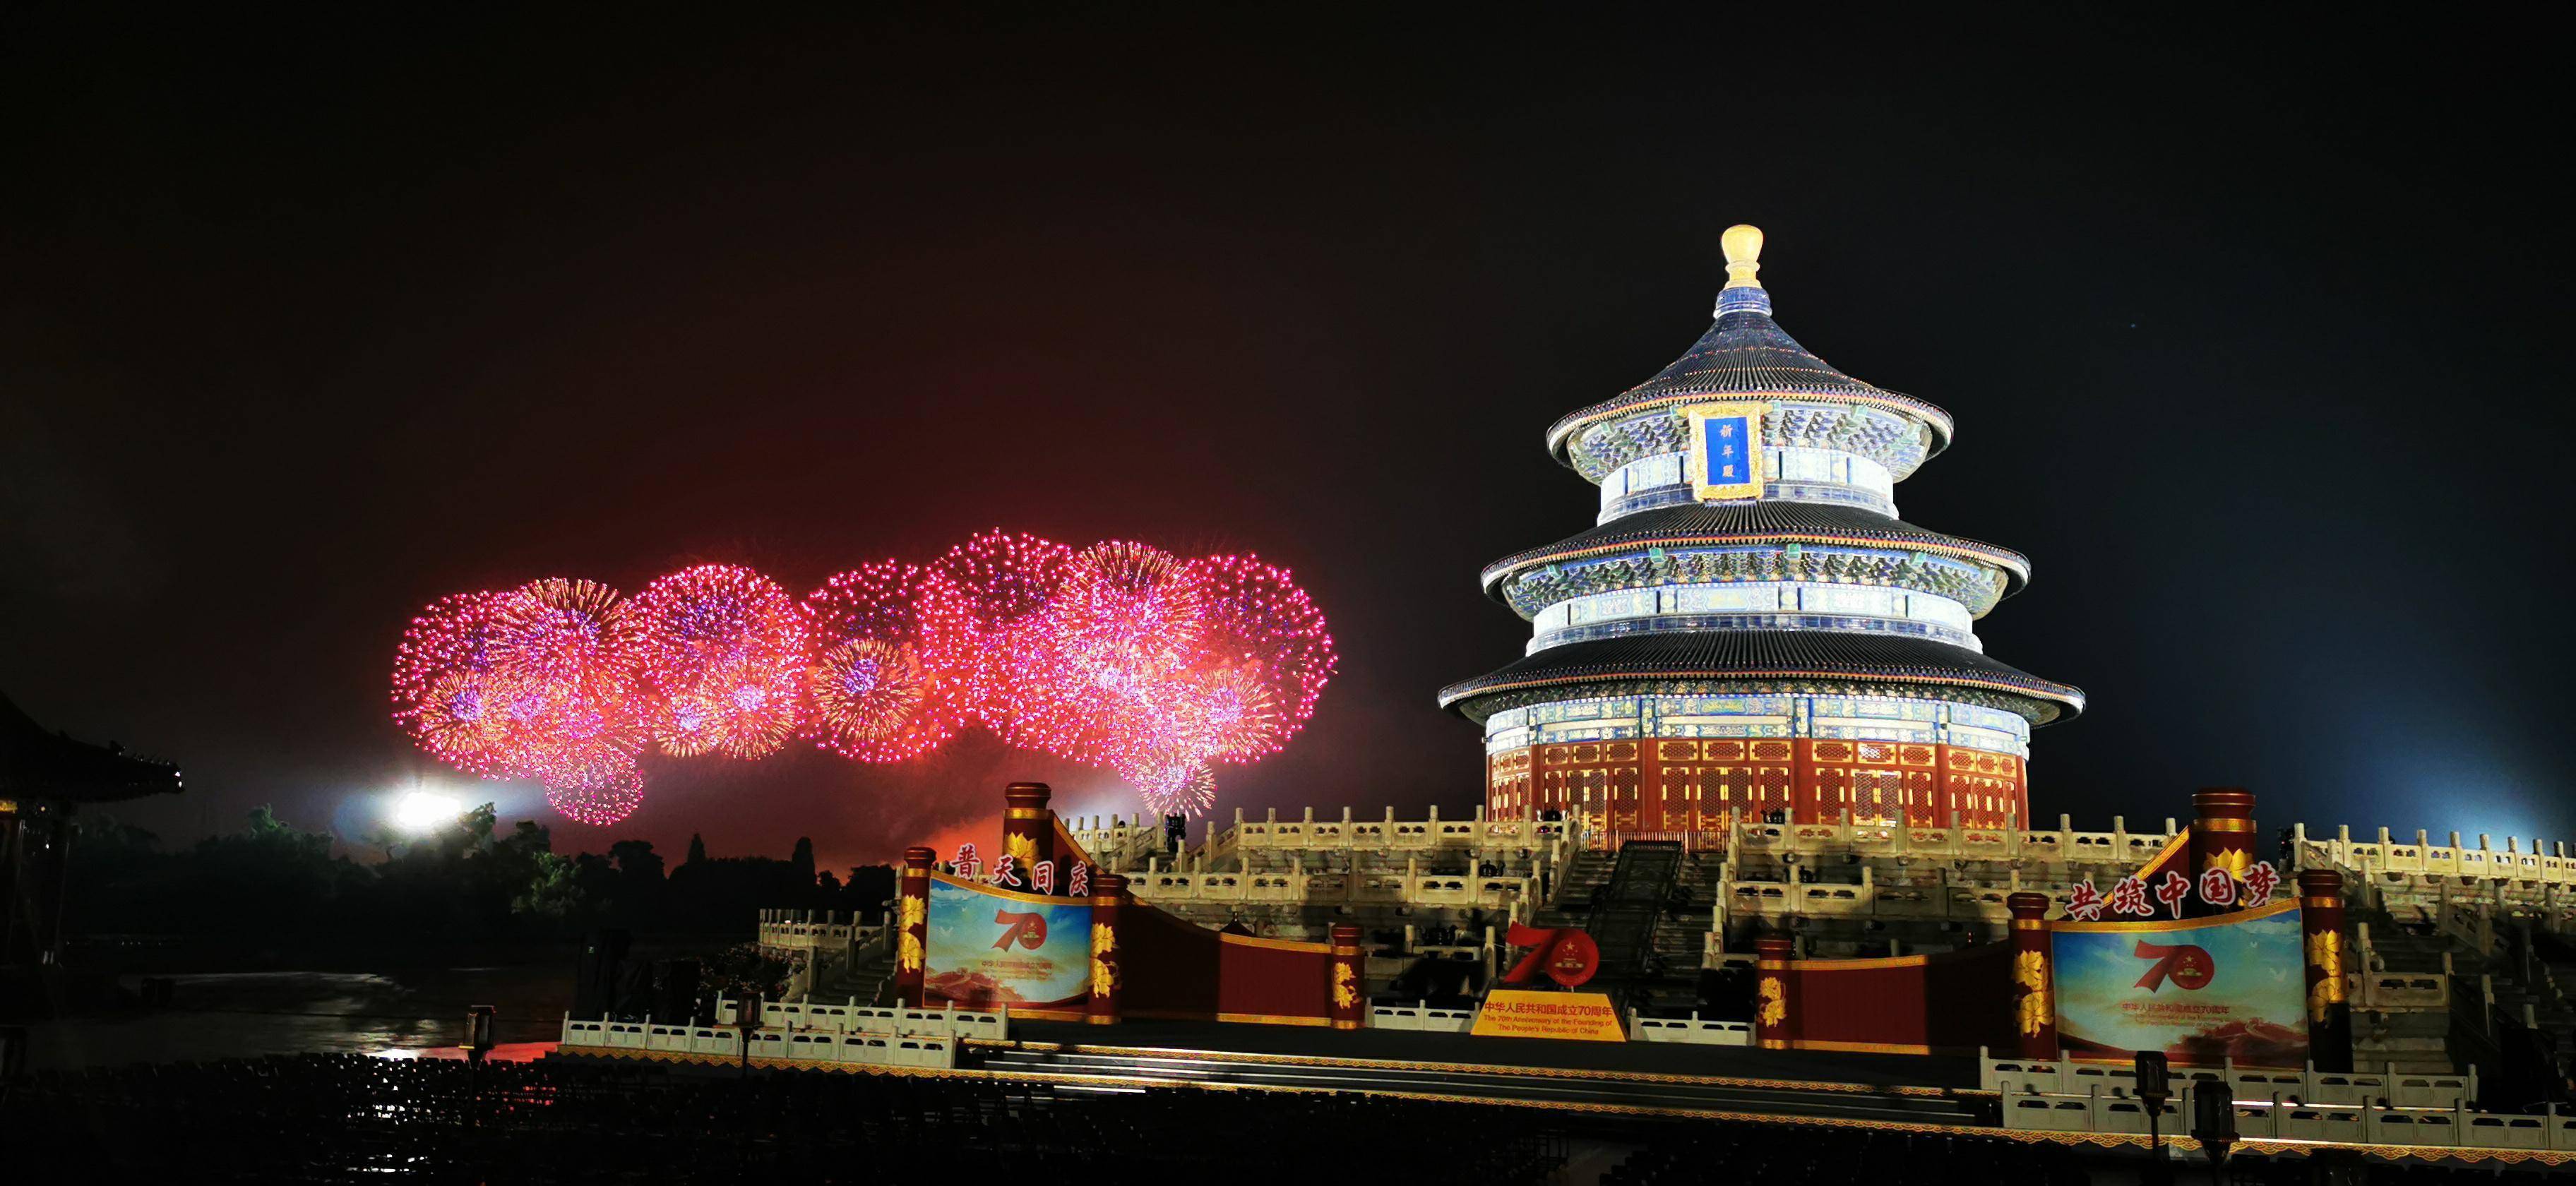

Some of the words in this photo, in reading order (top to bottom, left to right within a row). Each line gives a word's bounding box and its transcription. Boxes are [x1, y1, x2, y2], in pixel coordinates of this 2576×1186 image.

[950, 844, 1090, 897] 普天同庆
[2064, 861, 2281, 921] 共筑中国梦
[991, 909, 1048, 952] 70
[1504, 921, 1599, 987] 70
[2133, 939, 2215, 993] 70
[1484, 1001, 1613, 1017] 中华人民共和国成立70周年
